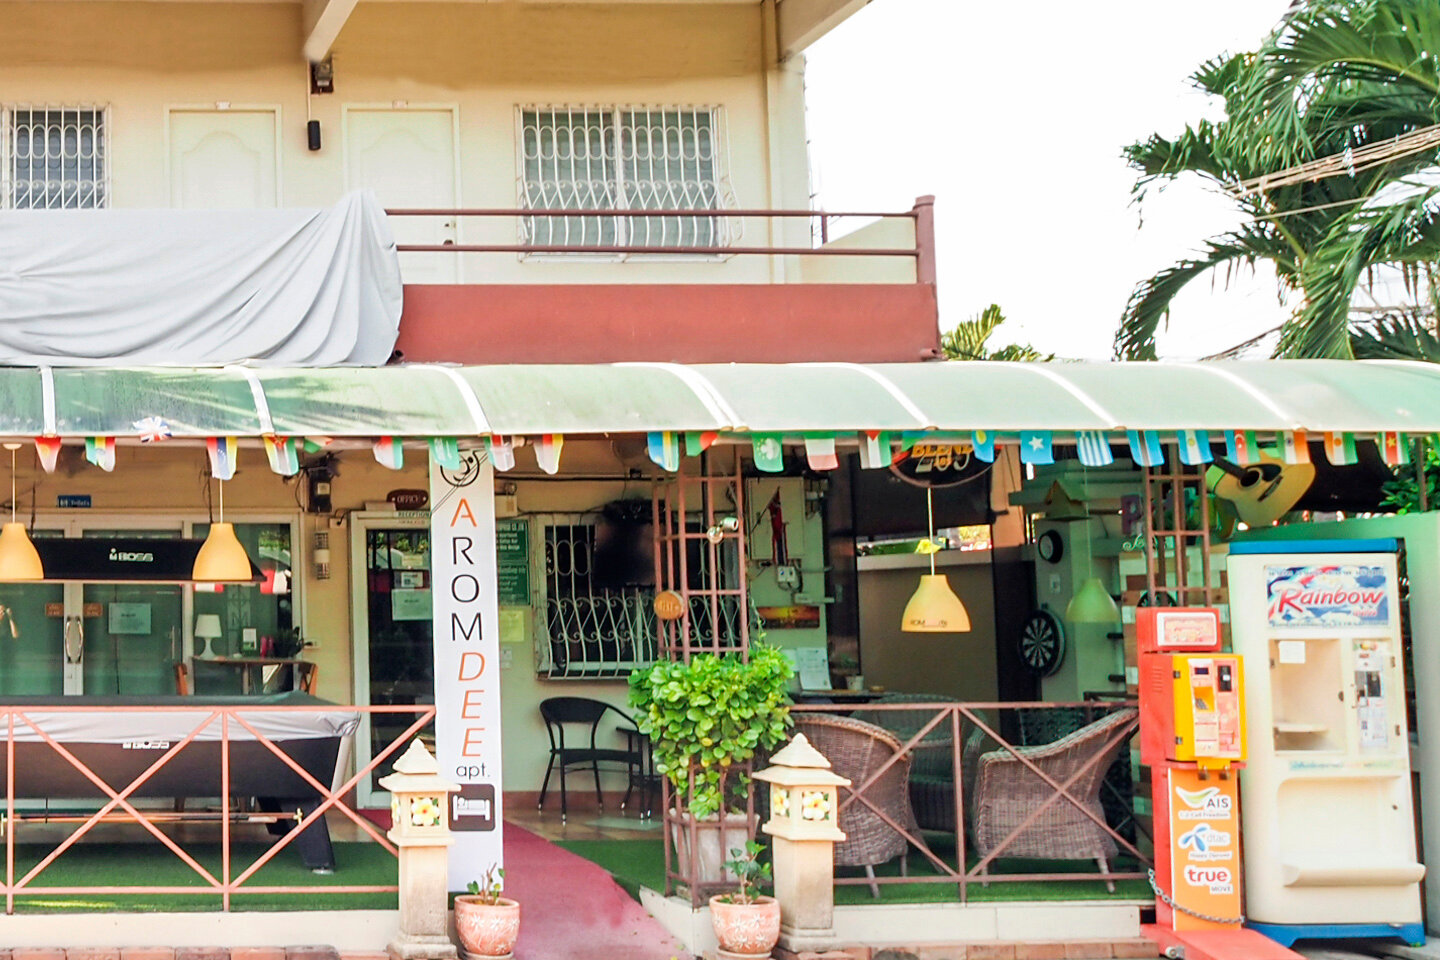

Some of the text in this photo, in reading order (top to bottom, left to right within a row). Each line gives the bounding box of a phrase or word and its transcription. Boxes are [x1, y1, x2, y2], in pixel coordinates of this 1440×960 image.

[397, 494, 419, 504] OFFICE
[1278, 585, 1384, 613] Rainbow
[449, 497, 487, 758] AROMDEE
[455, 762, 490, 780] apt.
[1206, 798, 1229, 809] AIS
[1188, 869, 1228, 882] true
